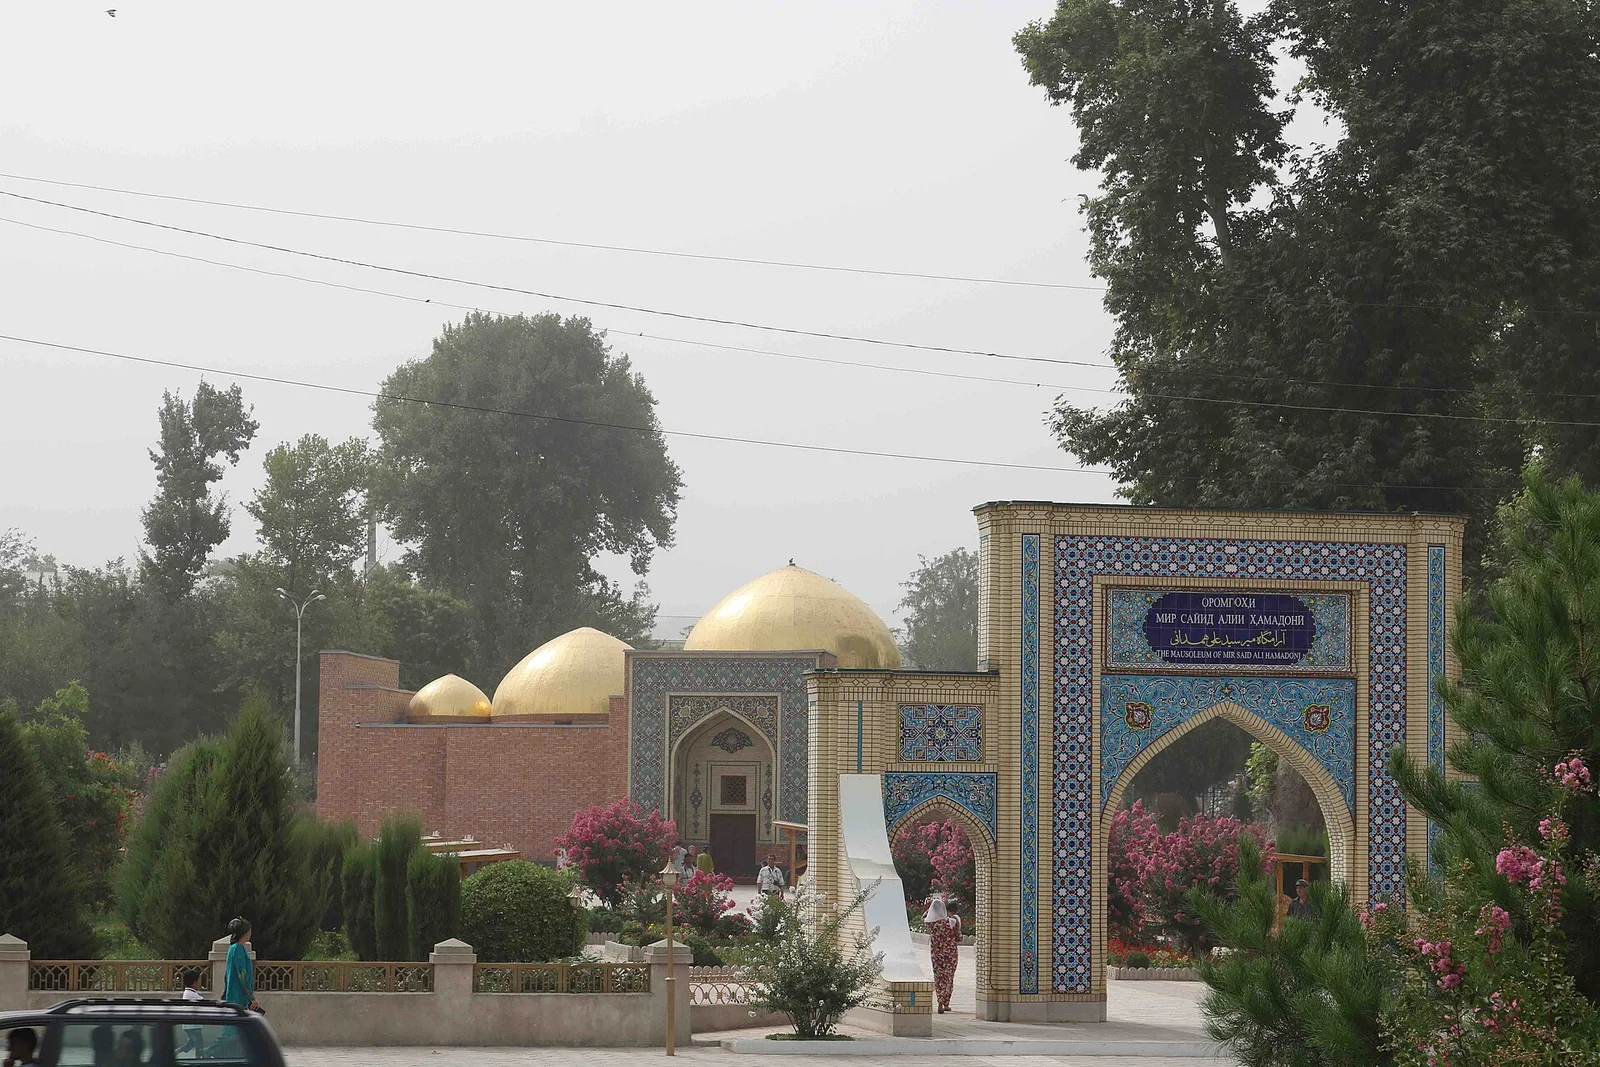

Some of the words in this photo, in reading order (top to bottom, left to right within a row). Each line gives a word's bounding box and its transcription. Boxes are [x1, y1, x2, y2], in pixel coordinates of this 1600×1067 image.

[1202, 597, 1256, 609] ОРОМГОҲИ
[1156, 613, 1177, 624] МИР
[1180, 612, 1214, 626] САЙИД
[1218, 614, 1245, 624] АЛИИ
[1257, 629, 1287, 647] آرامگاه
[1156, 650, 1170, 658] THE
[1170, 650, 1212, 658] MAUSOLEUM
[1213, 650, 1222, 658] OF
